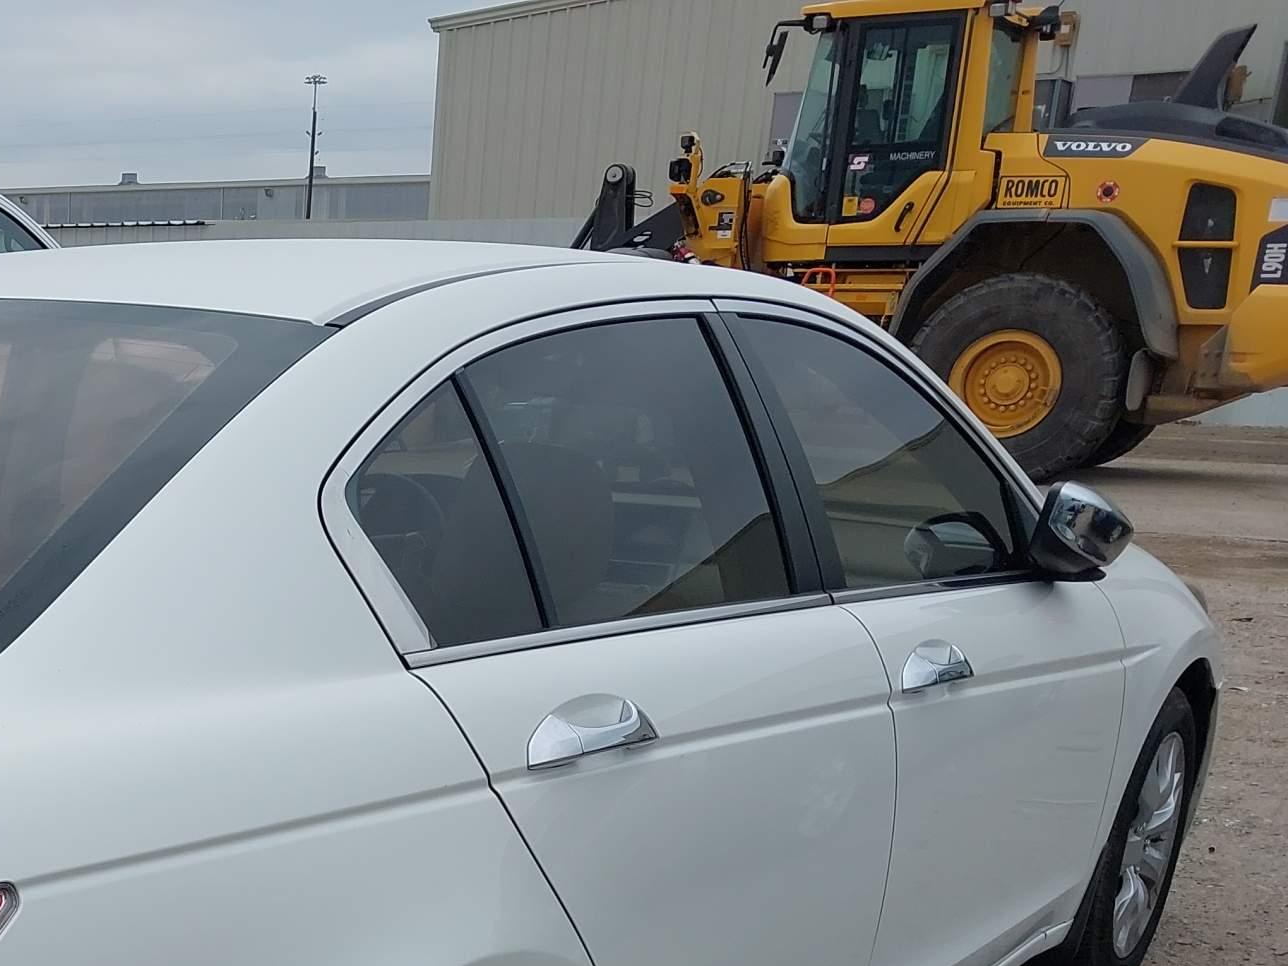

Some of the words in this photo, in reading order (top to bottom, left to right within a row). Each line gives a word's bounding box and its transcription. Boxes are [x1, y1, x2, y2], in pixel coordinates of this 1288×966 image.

[1053, 141, 1132, 152] VOLVO
[889, 151, 936, 161] MACHINERY
[1004, 178, 1059, 198] ROMCO
[1260, 243, 1288, 278] L90H
